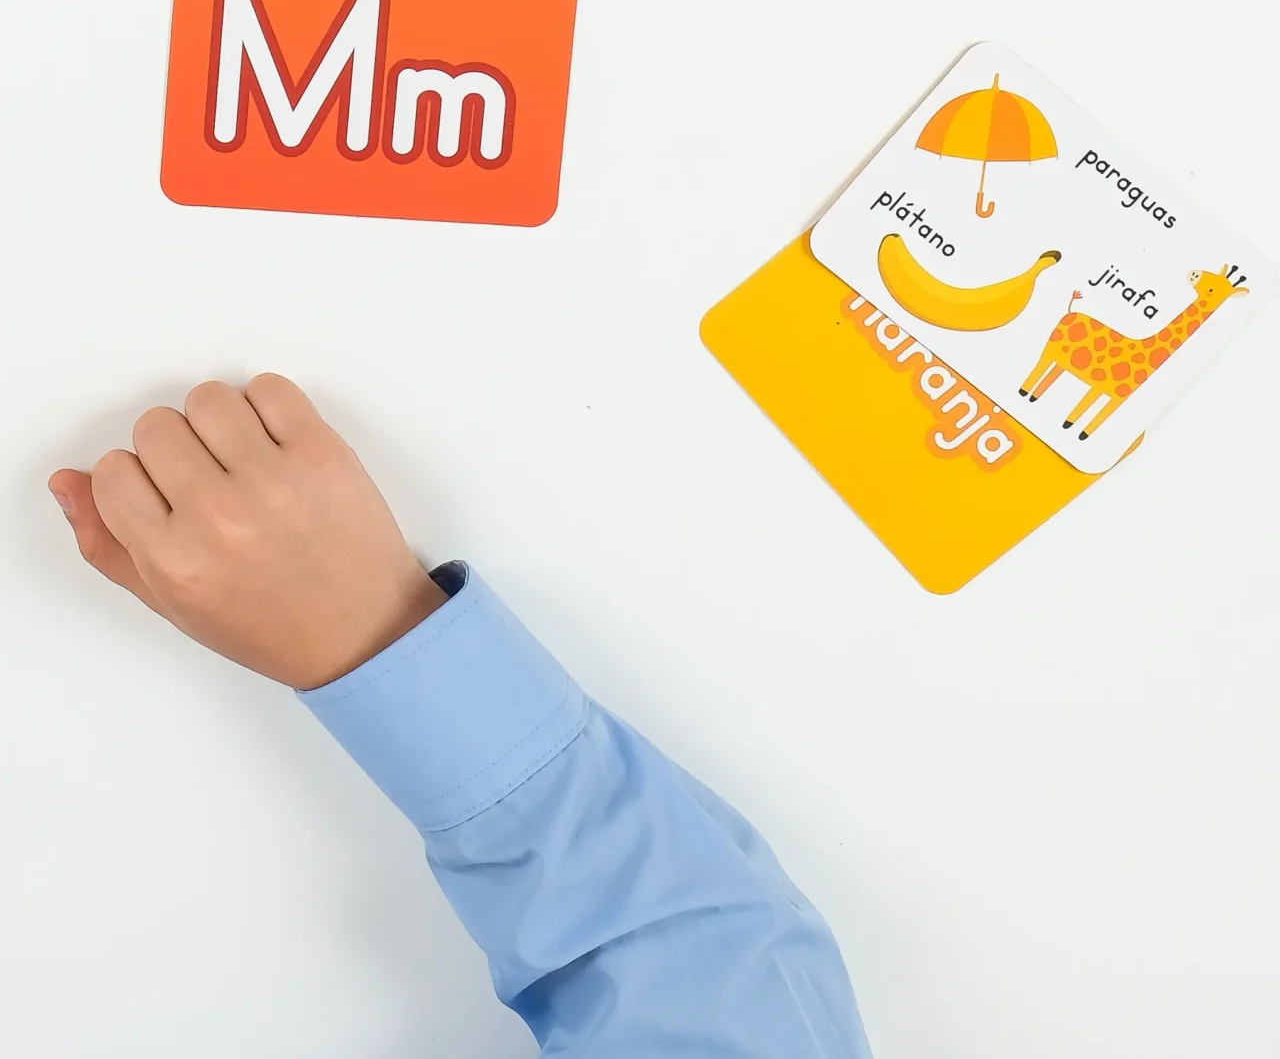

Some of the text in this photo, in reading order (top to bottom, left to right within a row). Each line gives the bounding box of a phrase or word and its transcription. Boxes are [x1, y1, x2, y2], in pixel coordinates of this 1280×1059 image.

[1075, 149, 1177, 229] paraguas
[869, 191, 956, 257] plátano
[1088, 264, 1159, 320] jirafa
